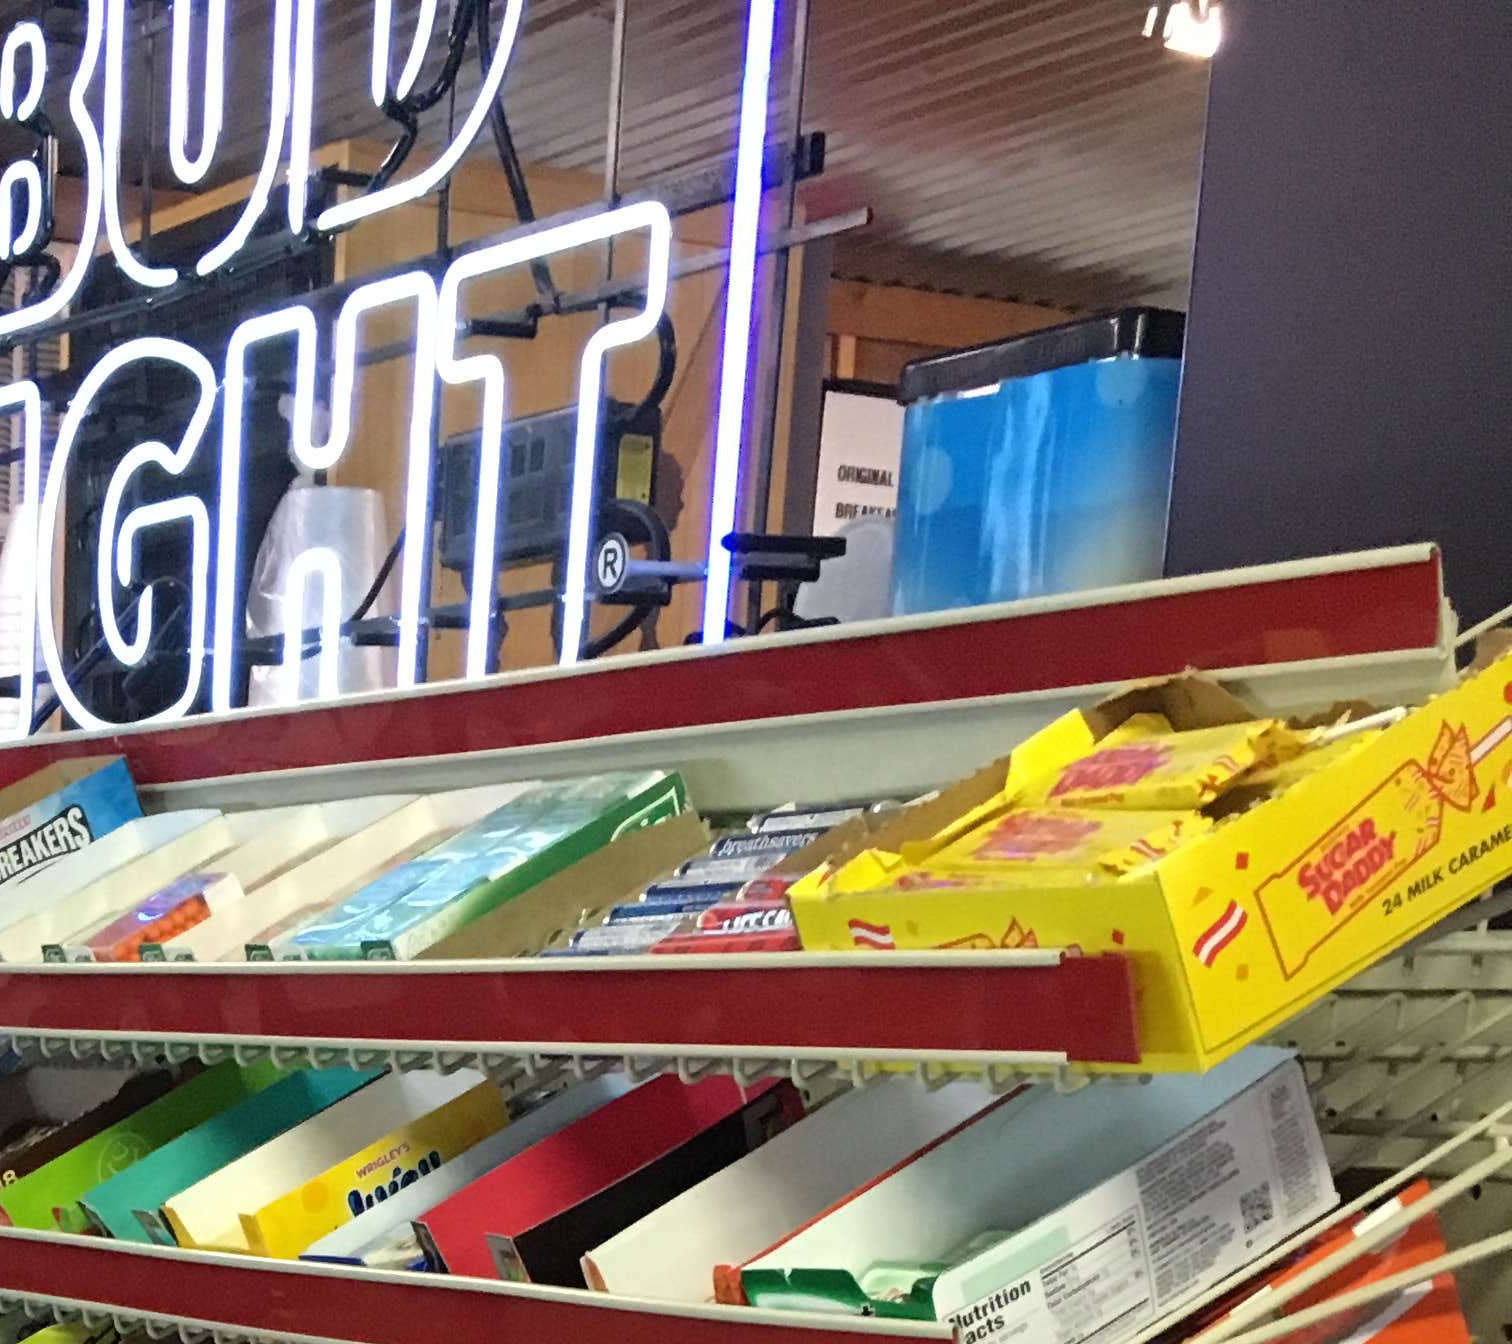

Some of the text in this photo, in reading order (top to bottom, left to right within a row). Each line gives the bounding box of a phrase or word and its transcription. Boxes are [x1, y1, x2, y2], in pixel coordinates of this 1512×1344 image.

[838, 465, 894, 487] ORIGINAL
[1298, 818, 1375, 900] SUGAR
[1321, 830, 1396, 915] DADDY
[1382, 824, 1512, 916] 24 MILK CARAME
[356, 1142, 410, 1178] WRIGLEY'S
